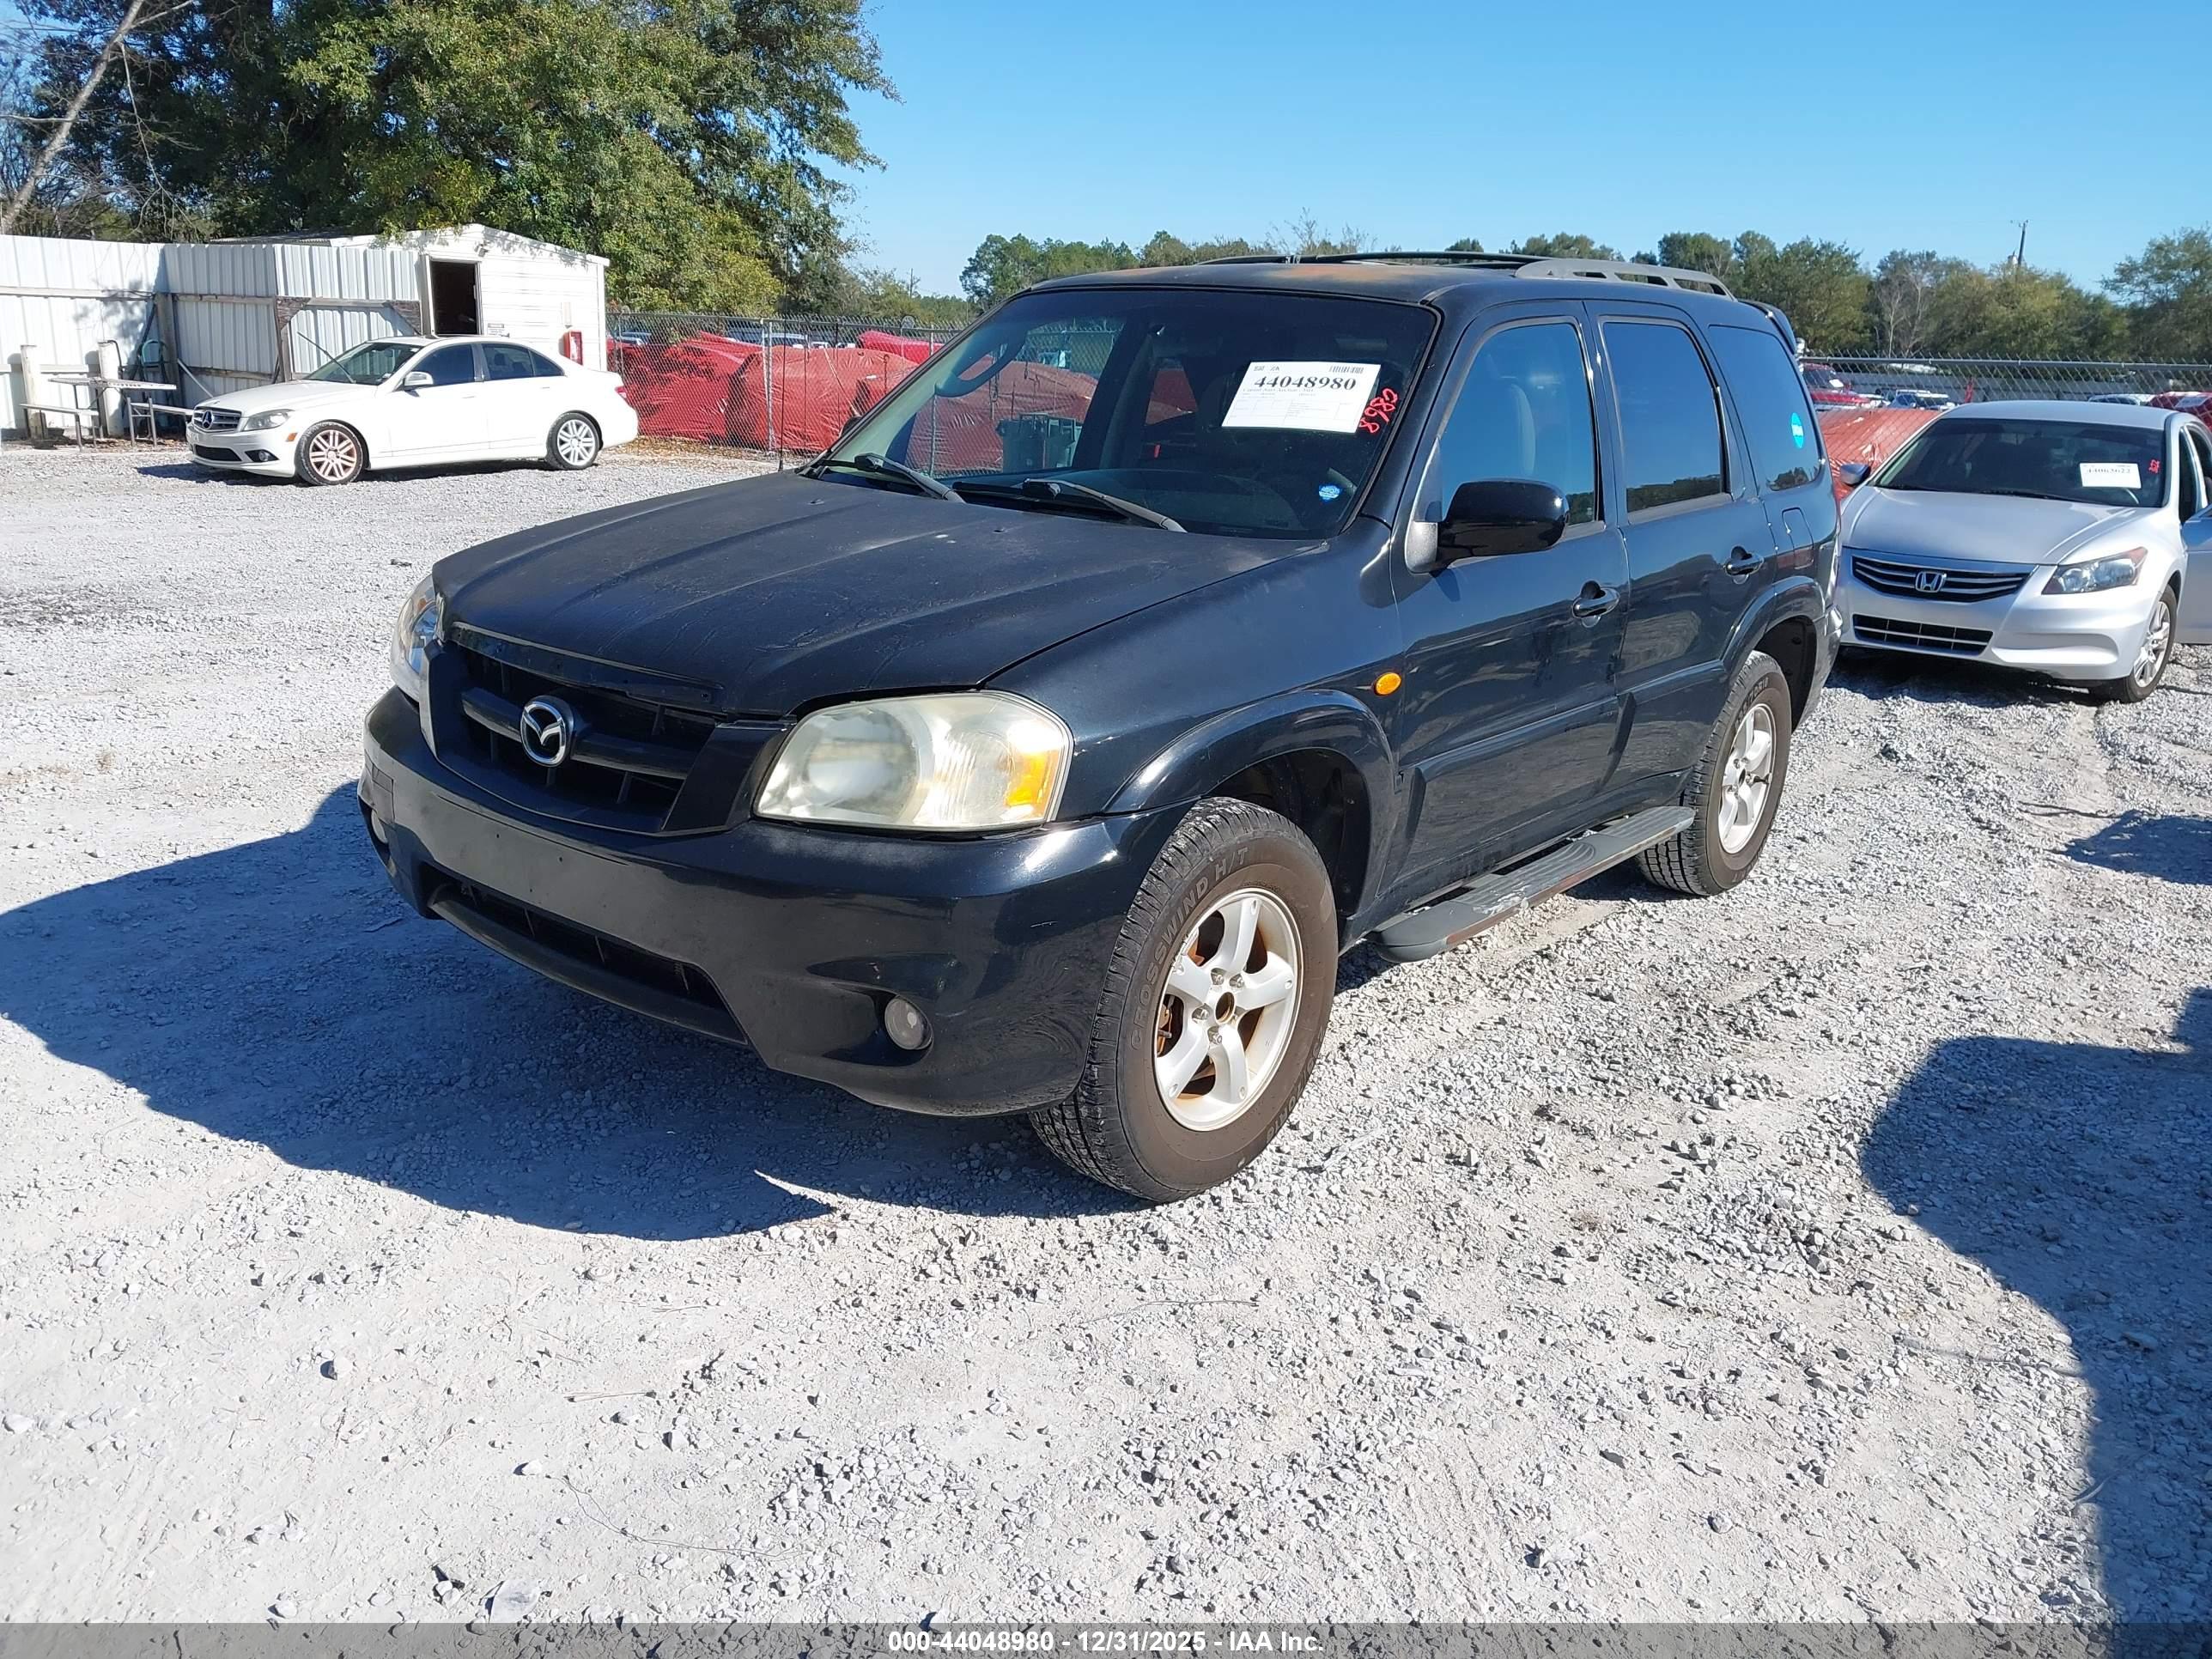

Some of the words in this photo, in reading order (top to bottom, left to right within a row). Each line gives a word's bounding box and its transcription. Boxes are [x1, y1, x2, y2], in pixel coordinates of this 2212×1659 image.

[1254, 375, 1357, 391] 44048980
[1130, 875, 1209, 1050] CROSSWIND
[1215, 848, 1249, 880] H/T
